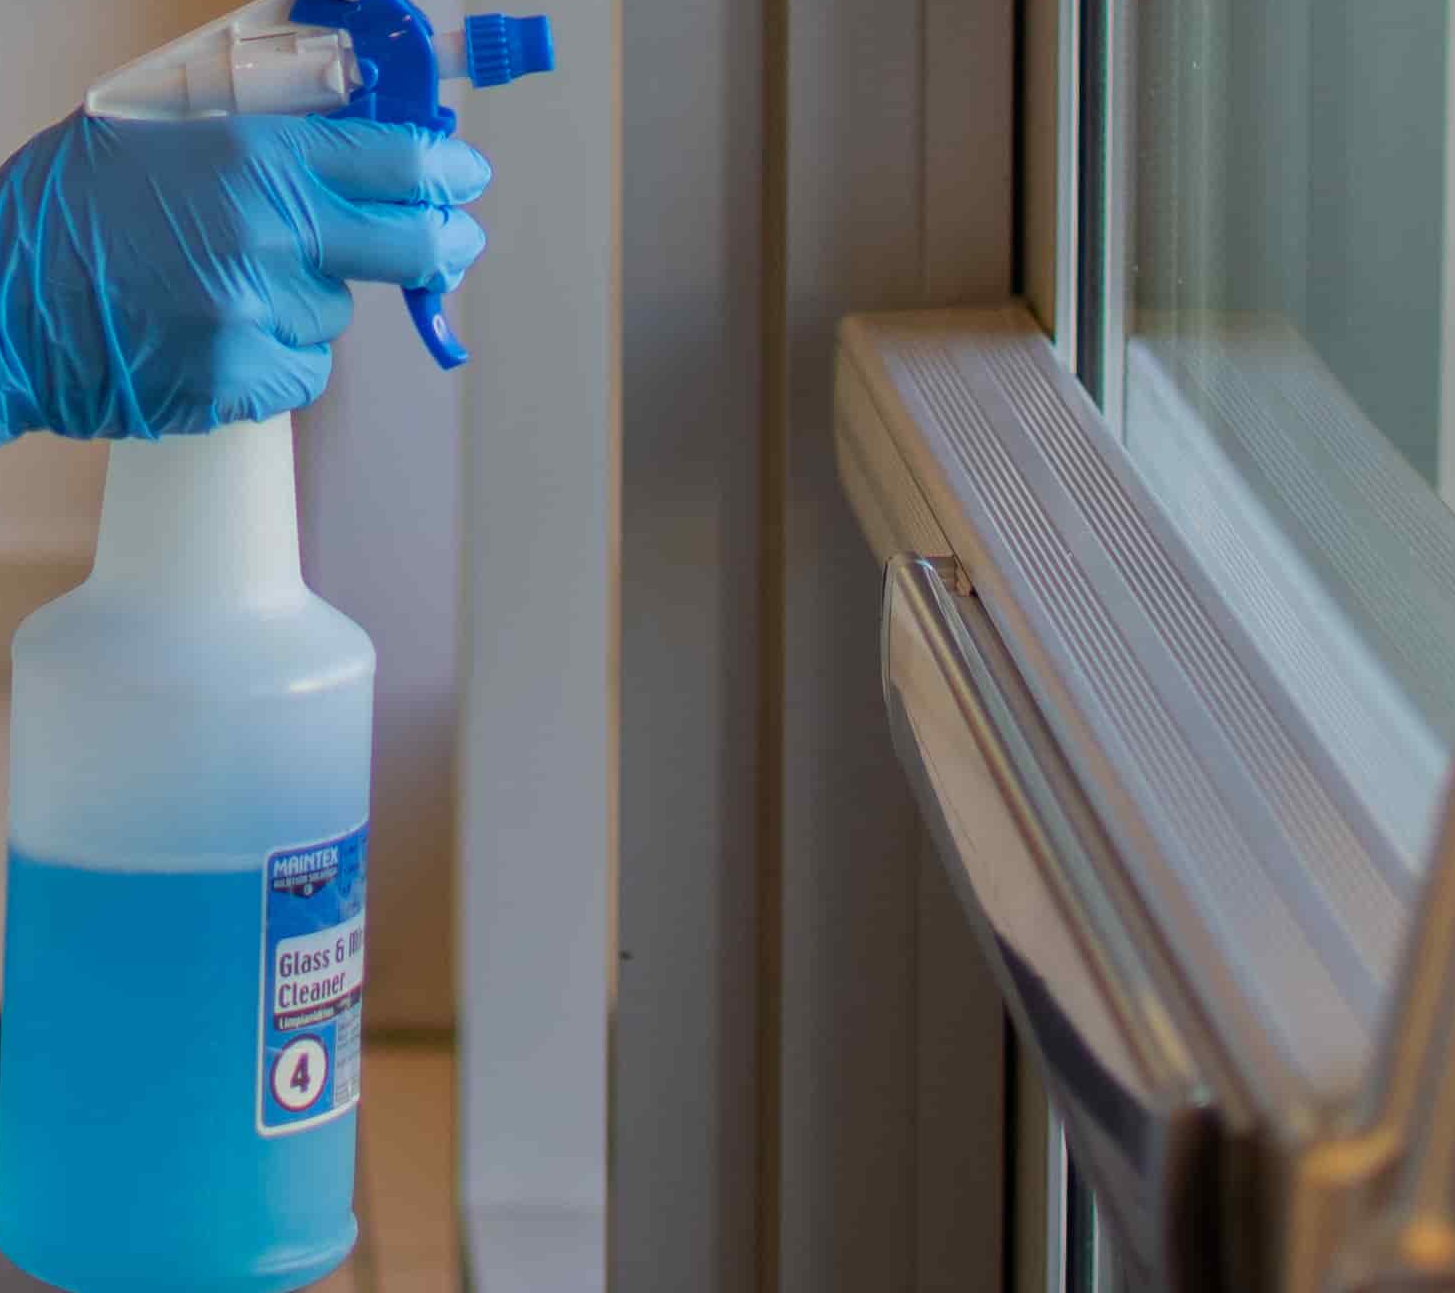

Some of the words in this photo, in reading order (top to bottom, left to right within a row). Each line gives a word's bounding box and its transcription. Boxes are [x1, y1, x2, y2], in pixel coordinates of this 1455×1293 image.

[273, 844, 339, 879] MAINTEX
[278, 948, 331, 979] Glass
[278, 970, 346, 1010] Cleaner
[290, 1051, 310, 1094] 4
